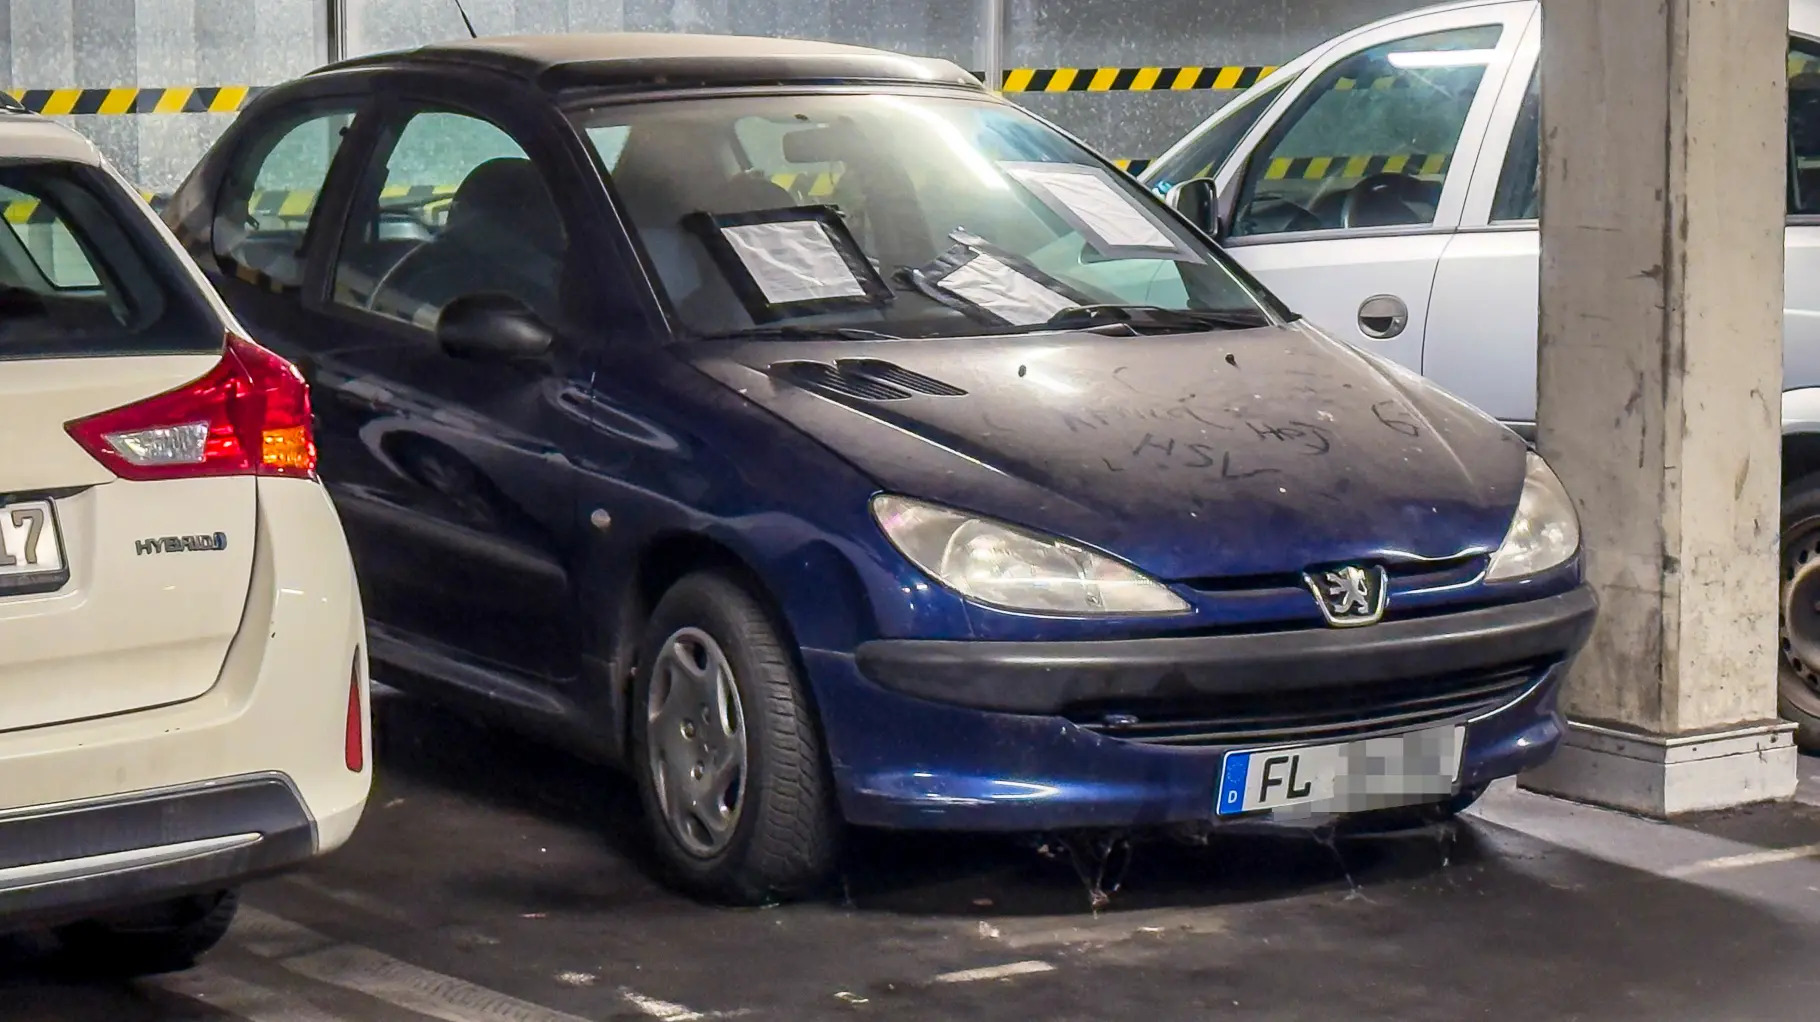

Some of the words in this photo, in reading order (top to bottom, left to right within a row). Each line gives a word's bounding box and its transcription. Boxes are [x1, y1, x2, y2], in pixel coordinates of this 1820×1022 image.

[134, 534, 214, 556] HYBRID
[1227, 790, 1238, 804] D
[1259, 754, 1312, 803] FL
